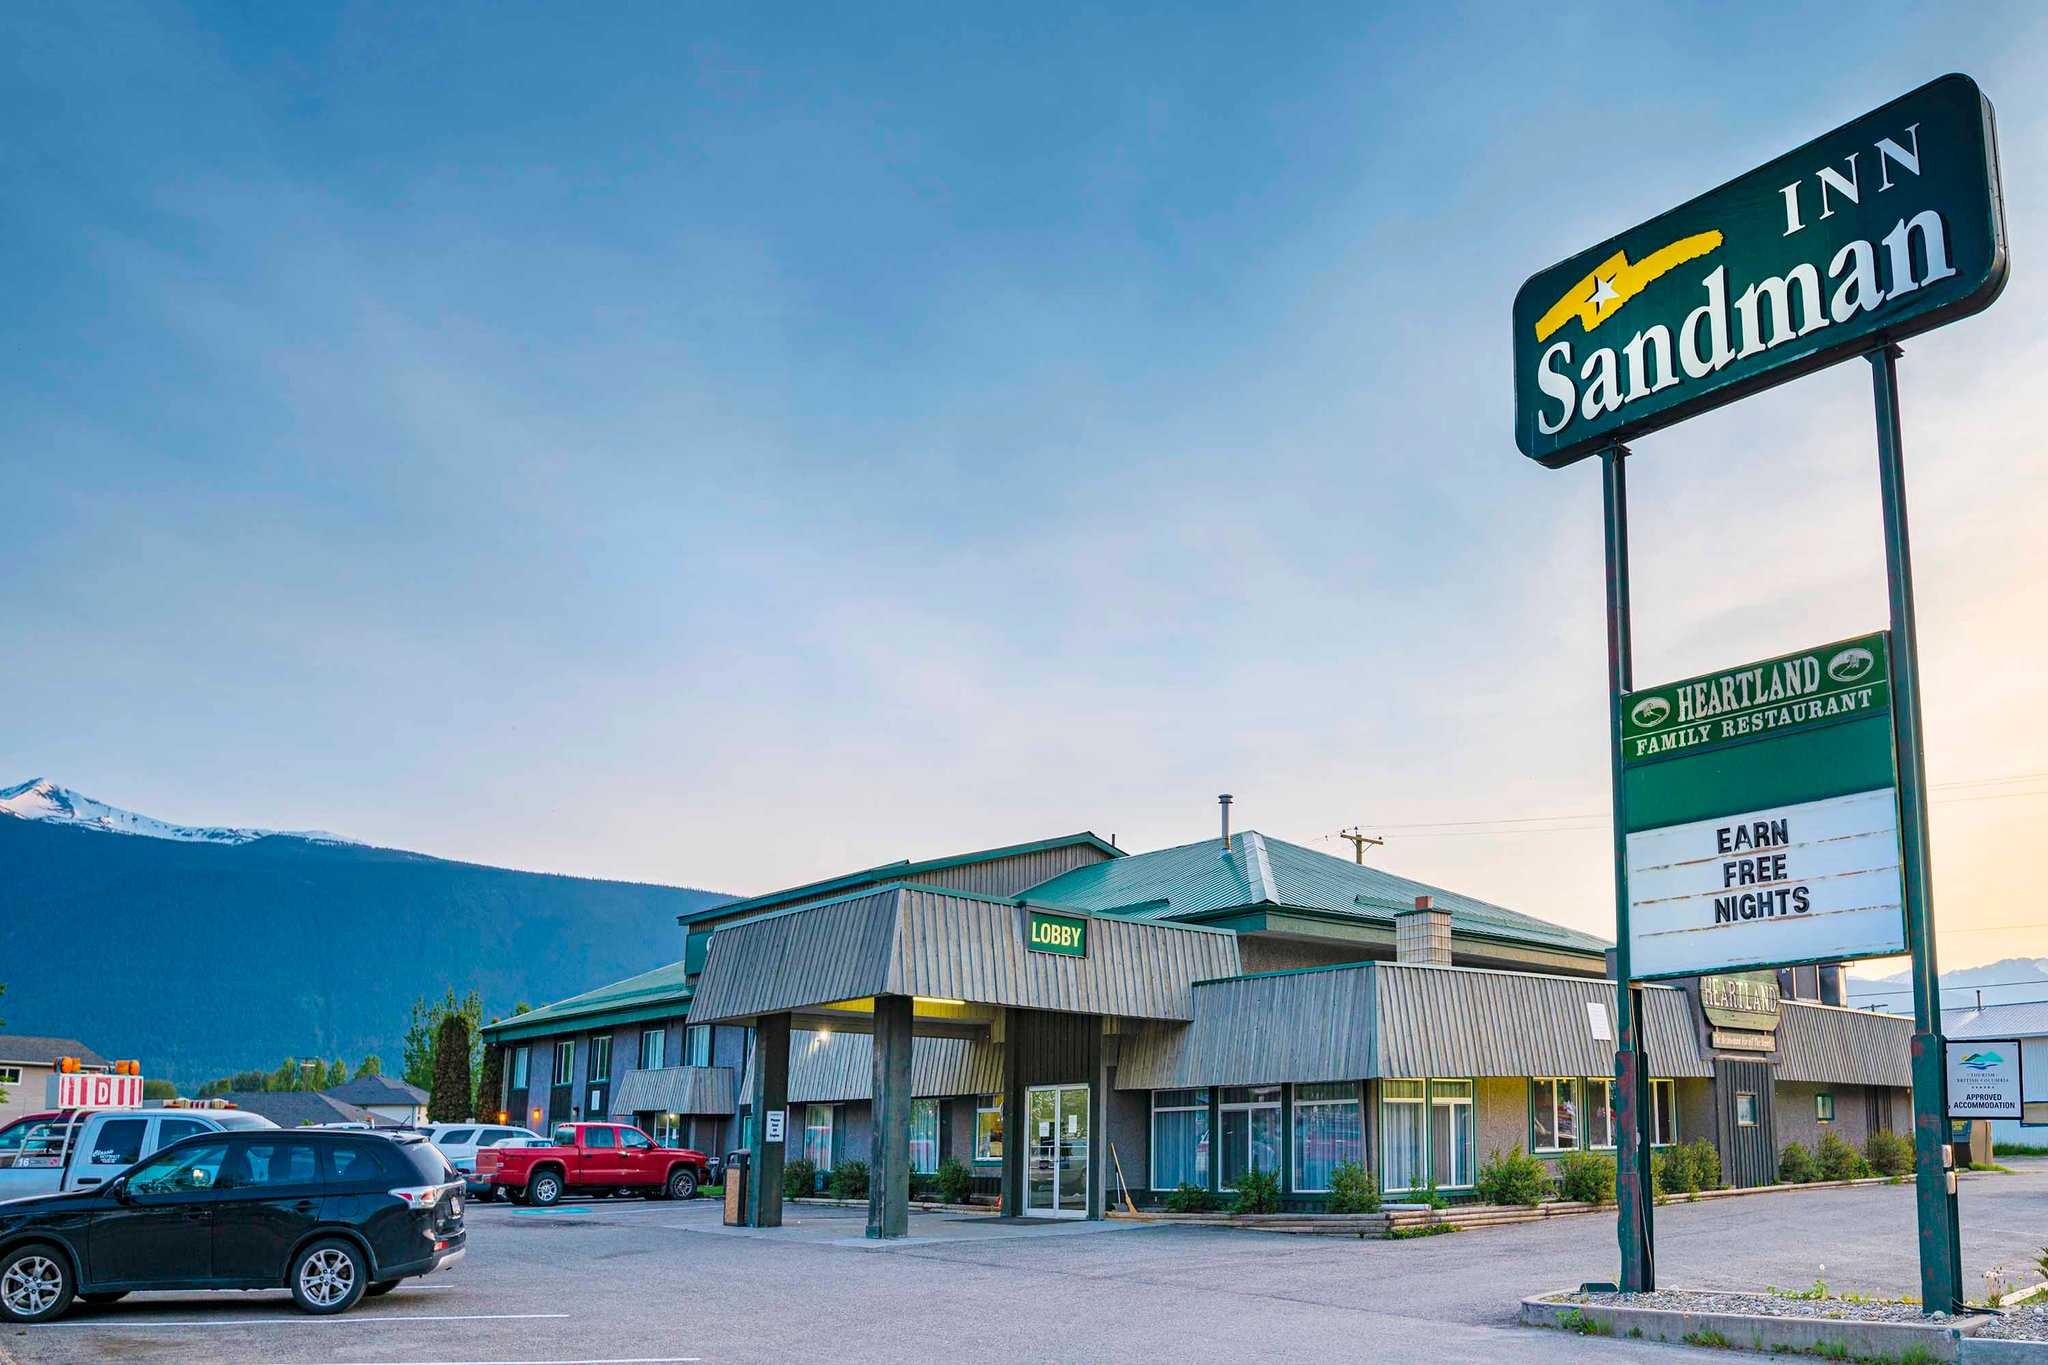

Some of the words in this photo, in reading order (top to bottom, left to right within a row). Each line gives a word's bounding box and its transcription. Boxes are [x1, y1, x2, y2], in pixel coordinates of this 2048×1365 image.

[1779, 122, 1920, 237] INN
[1536, 209, 1956, 435] Sandman
[1677, 655, 1821, 723] HEARTLAND
[1636, 724, 1712, 757] FAMILY
[1721, 688, 1872, 738] RESTAURANT
[1716, 818, 1789, 854] EARN
[1723, 853, 1788, 888] FREE
[1714, 886, 1810, 924] NIGHTS
[1031, 921, 1082, 947] LOBBY
[1703, 976, 1777, 1013] HEARTLAND
[97, 1081, 109, 1104] D
[1953, 1101, 2016, 1109] ACCOMMODATION
[1966, 1093, 2002, 1101] APPROVED
